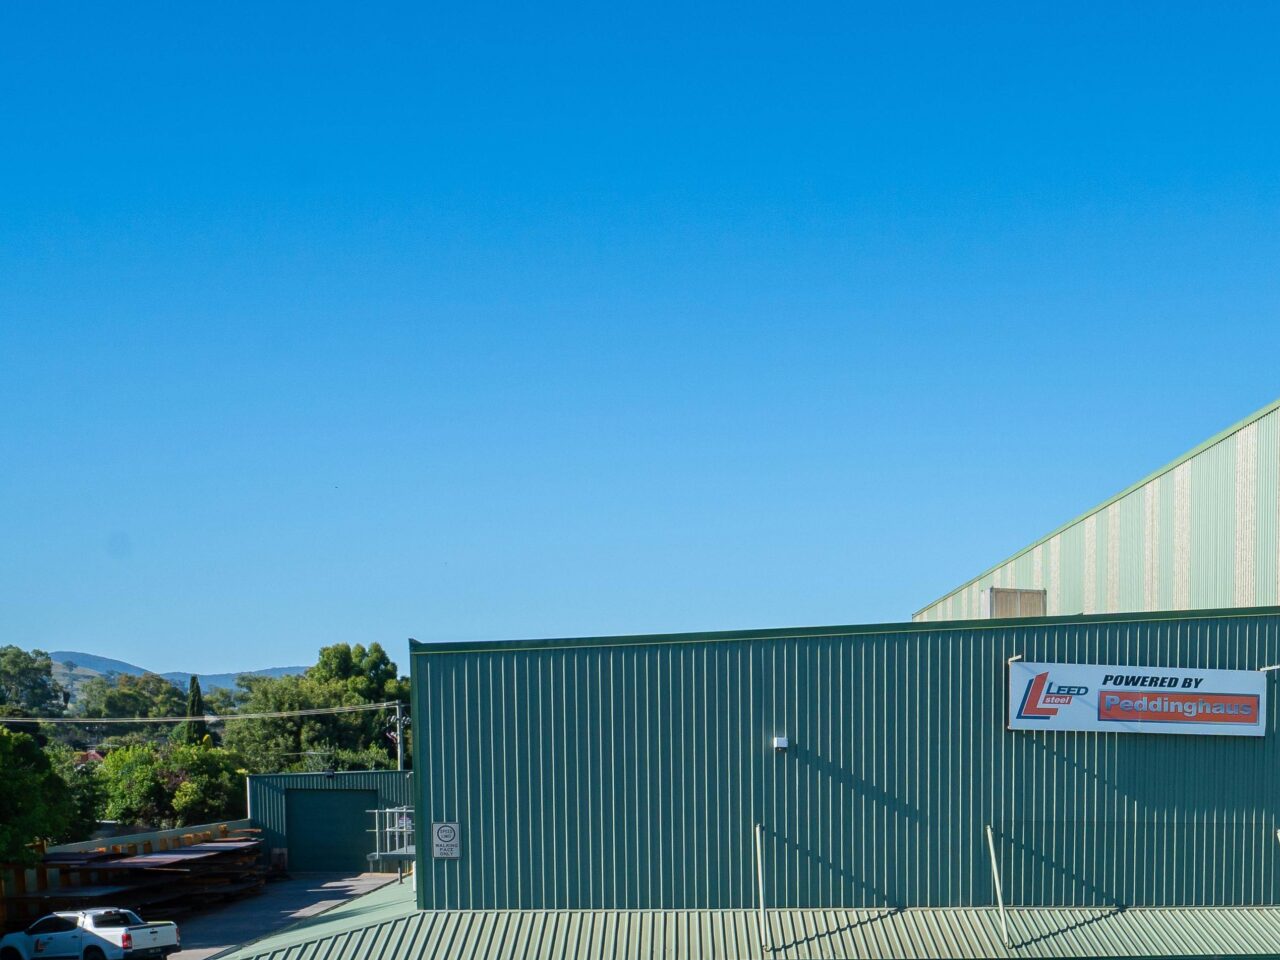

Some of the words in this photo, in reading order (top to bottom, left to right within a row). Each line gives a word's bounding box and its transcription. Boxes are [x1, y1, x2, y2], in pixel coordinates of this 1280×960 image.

[1046, 681, 1089, 696] LEED
[1102, 674, 1181, 688] POWERED
[1182, 677, 1204, 689] BY
[1045, 695, 1071, 704] steel
[1104, 695, 1252, 717] Peddinghaus
